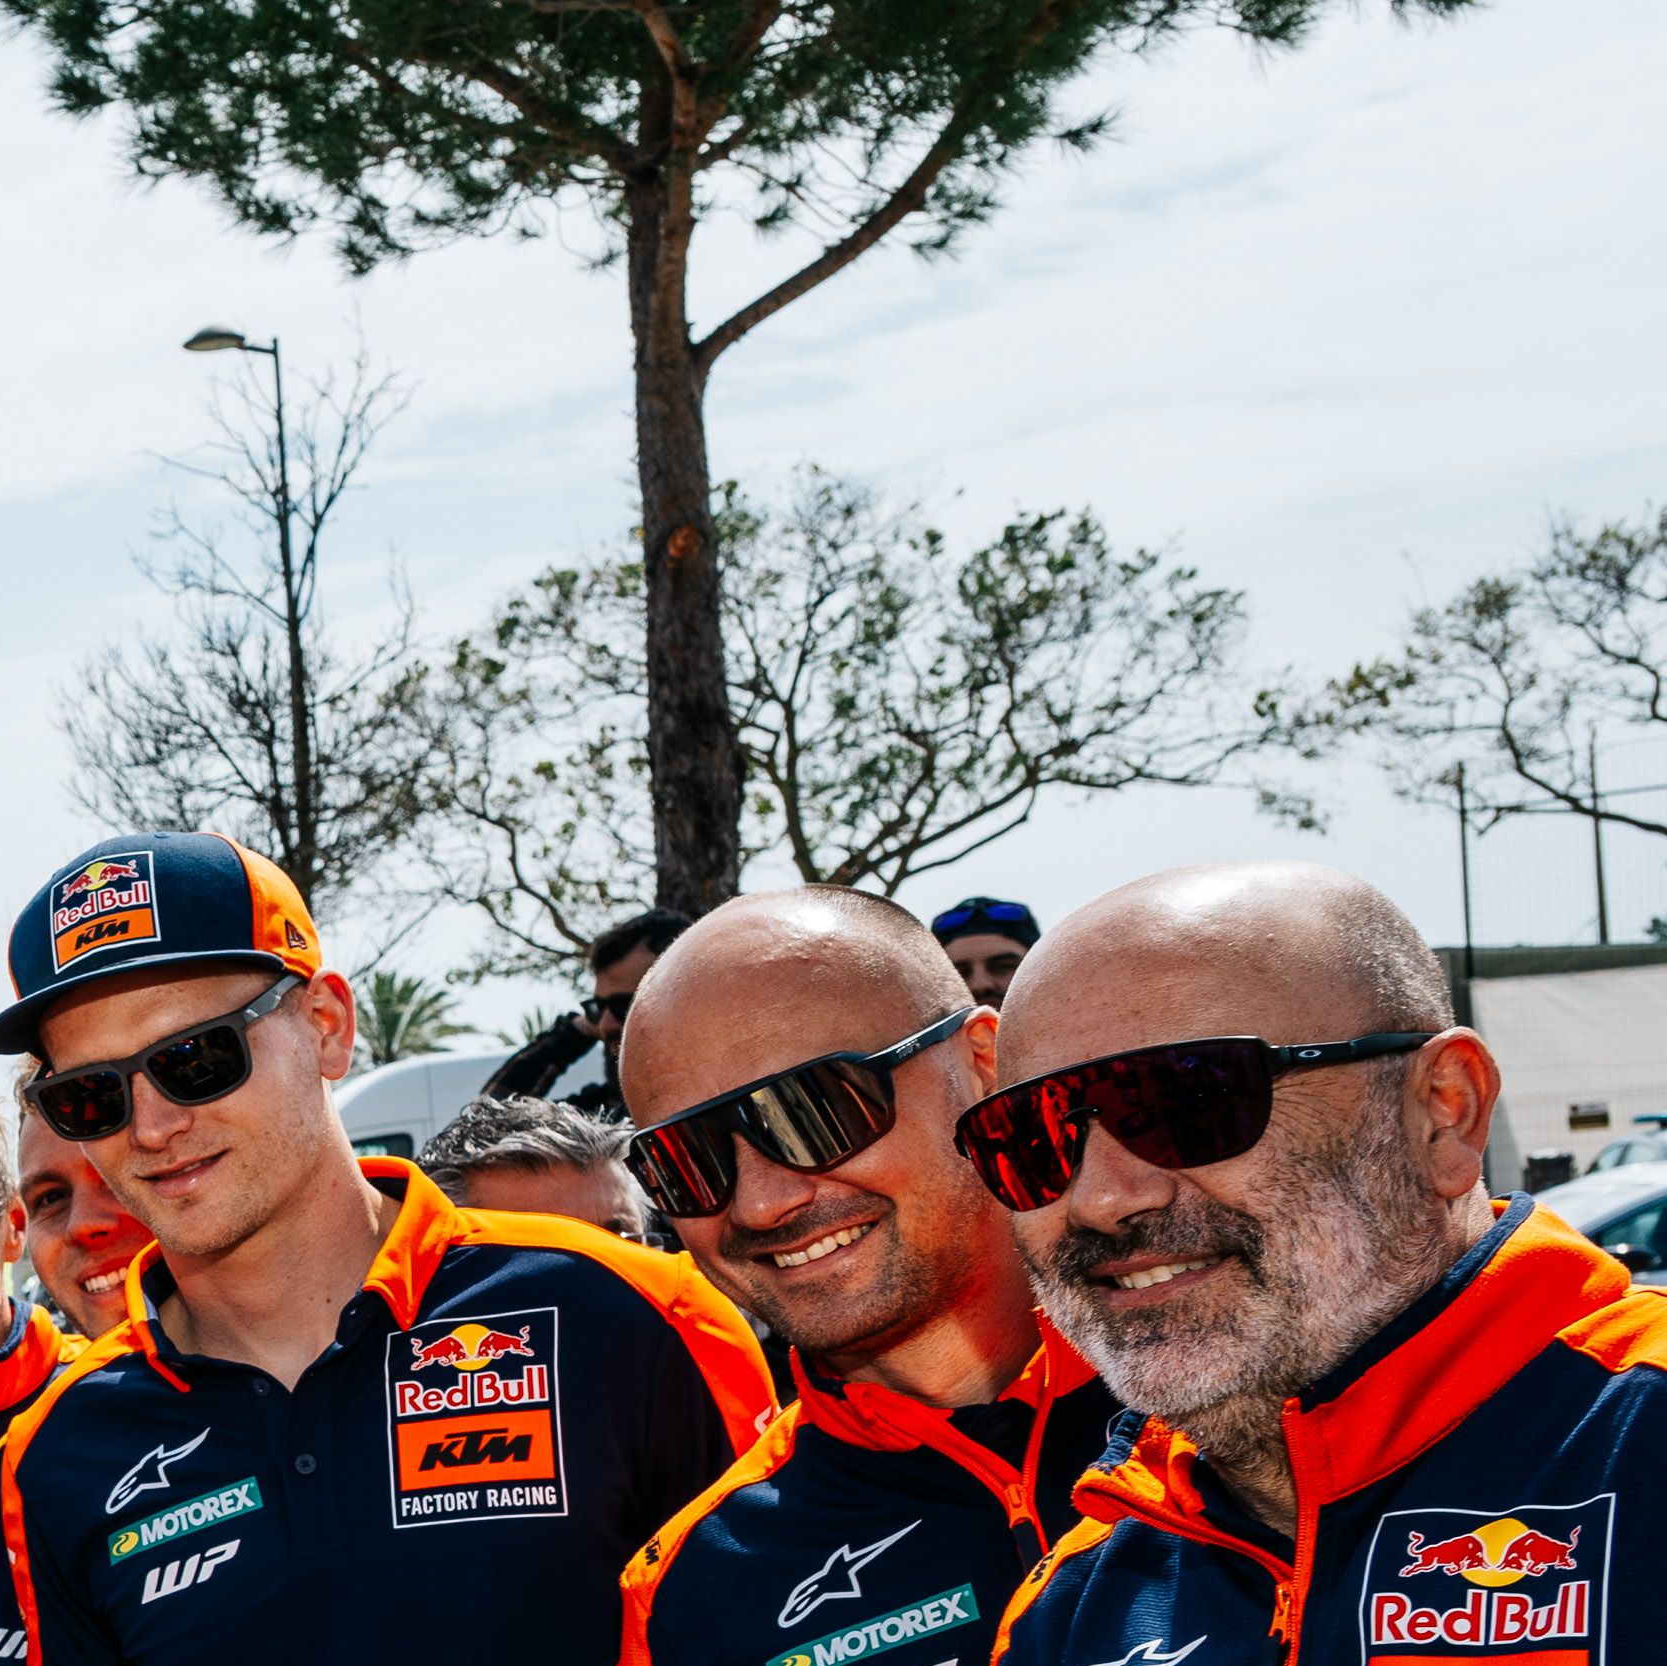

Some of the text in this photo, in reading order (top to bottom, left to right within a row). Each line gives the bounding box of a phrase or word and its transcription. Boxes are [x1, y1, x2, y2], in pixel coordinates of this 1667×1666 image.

[53, 880, 151, 933] Red Bull
[75, 918, 131, 951] KTM
[396, 1365, 547, 1417] Red Bull
[418, 1426, 533, 1471] KTM
[140, 1484, 255, 1546] MOTOREX
[400, 1484, 558, 1517] FACTORY RACING
[141, 1539, 241, 1605] WP
[1370, 1580, 1590, 1646] Red Bull
